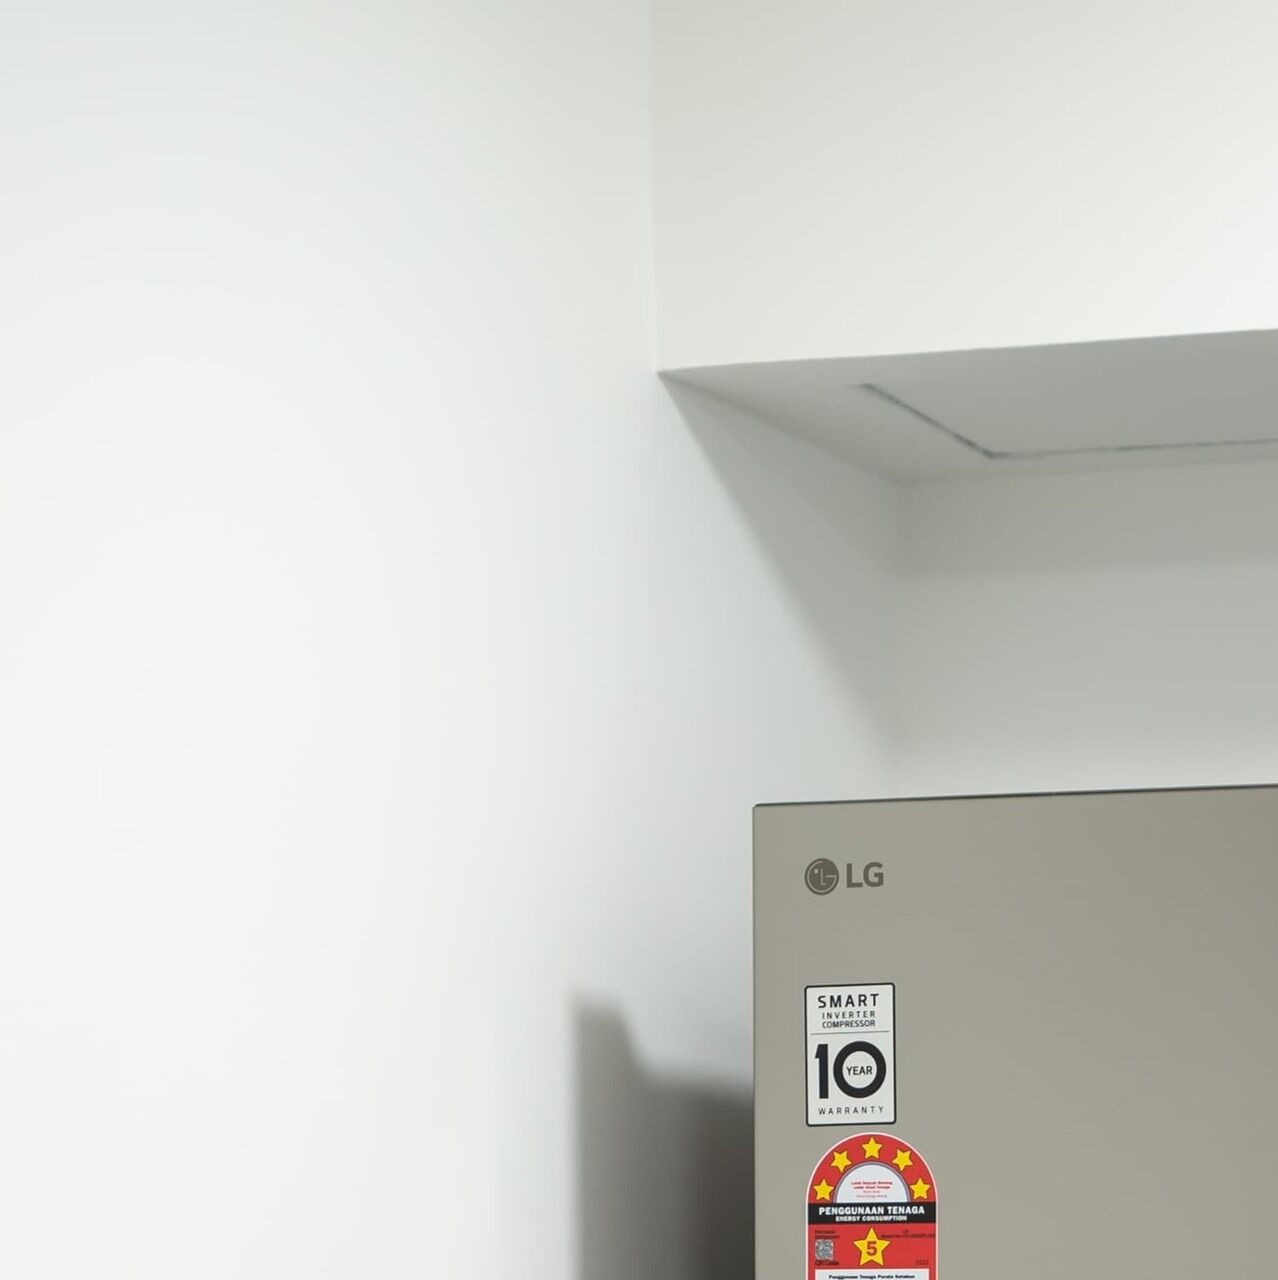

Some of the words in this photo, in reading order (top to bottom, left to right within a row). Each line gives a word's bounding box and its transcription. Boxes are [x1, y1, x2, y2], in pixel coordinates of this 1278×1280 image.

[846, 861, 884, 888] LG
[817, 993, 880, 1009] SMART
[822, 1010, 876, 1020] INVERTER
[822, 1019, 876, 1029] COMPRESSOR
[814, 1040, 887, 1099] 10
[846, 1065, 874, 1076] YEAR
[818, 1105, 884, 1115] WARRANTY
[818, 1206, 884, 1216] PENGGUNAAN
[887, 1205, 925, 1215] TENAGA
[866, 1240, 878, 1257] 5
